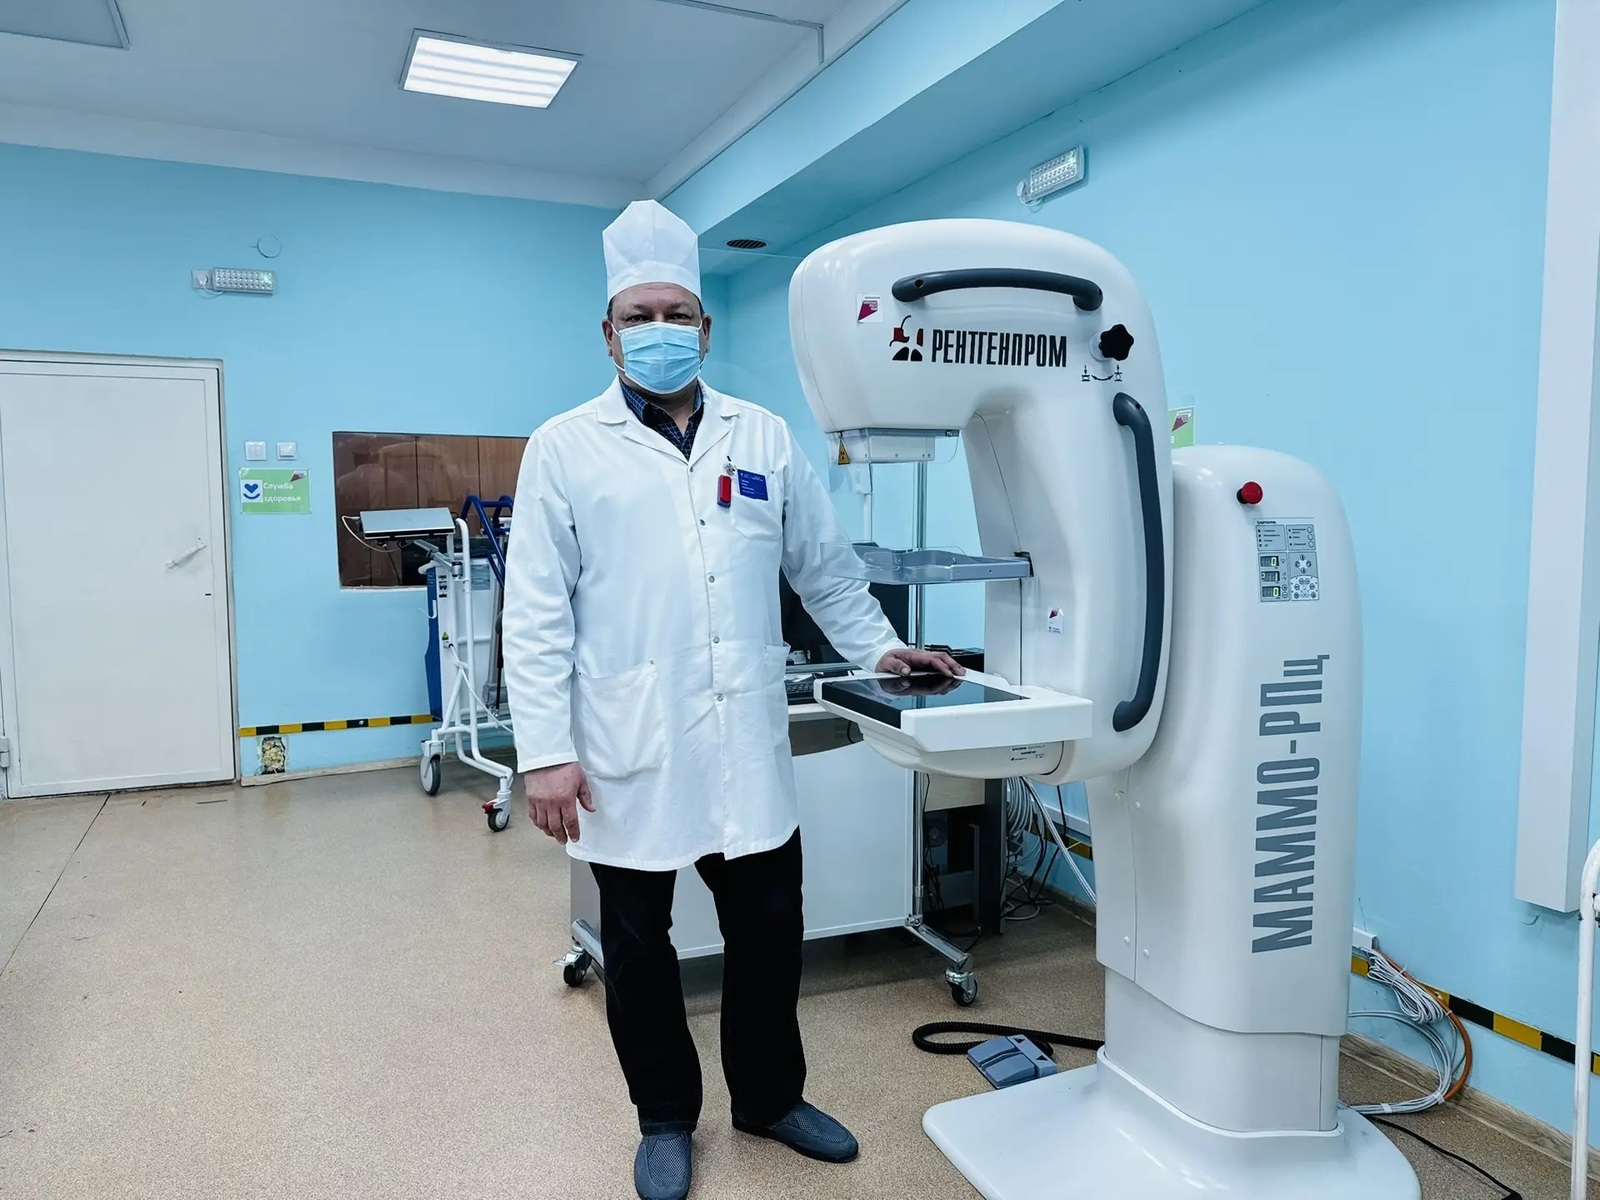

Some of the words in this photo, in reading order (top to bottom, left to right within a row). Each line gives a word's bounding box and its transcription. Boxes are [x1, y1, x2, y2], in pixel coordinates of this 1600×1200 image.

[931, 328, 1067, 367] РЕНТГЕНПРОМ
[263, 482, 294, 490] Служба
[1252, 654, 1330, 954] МАММО-РПц
